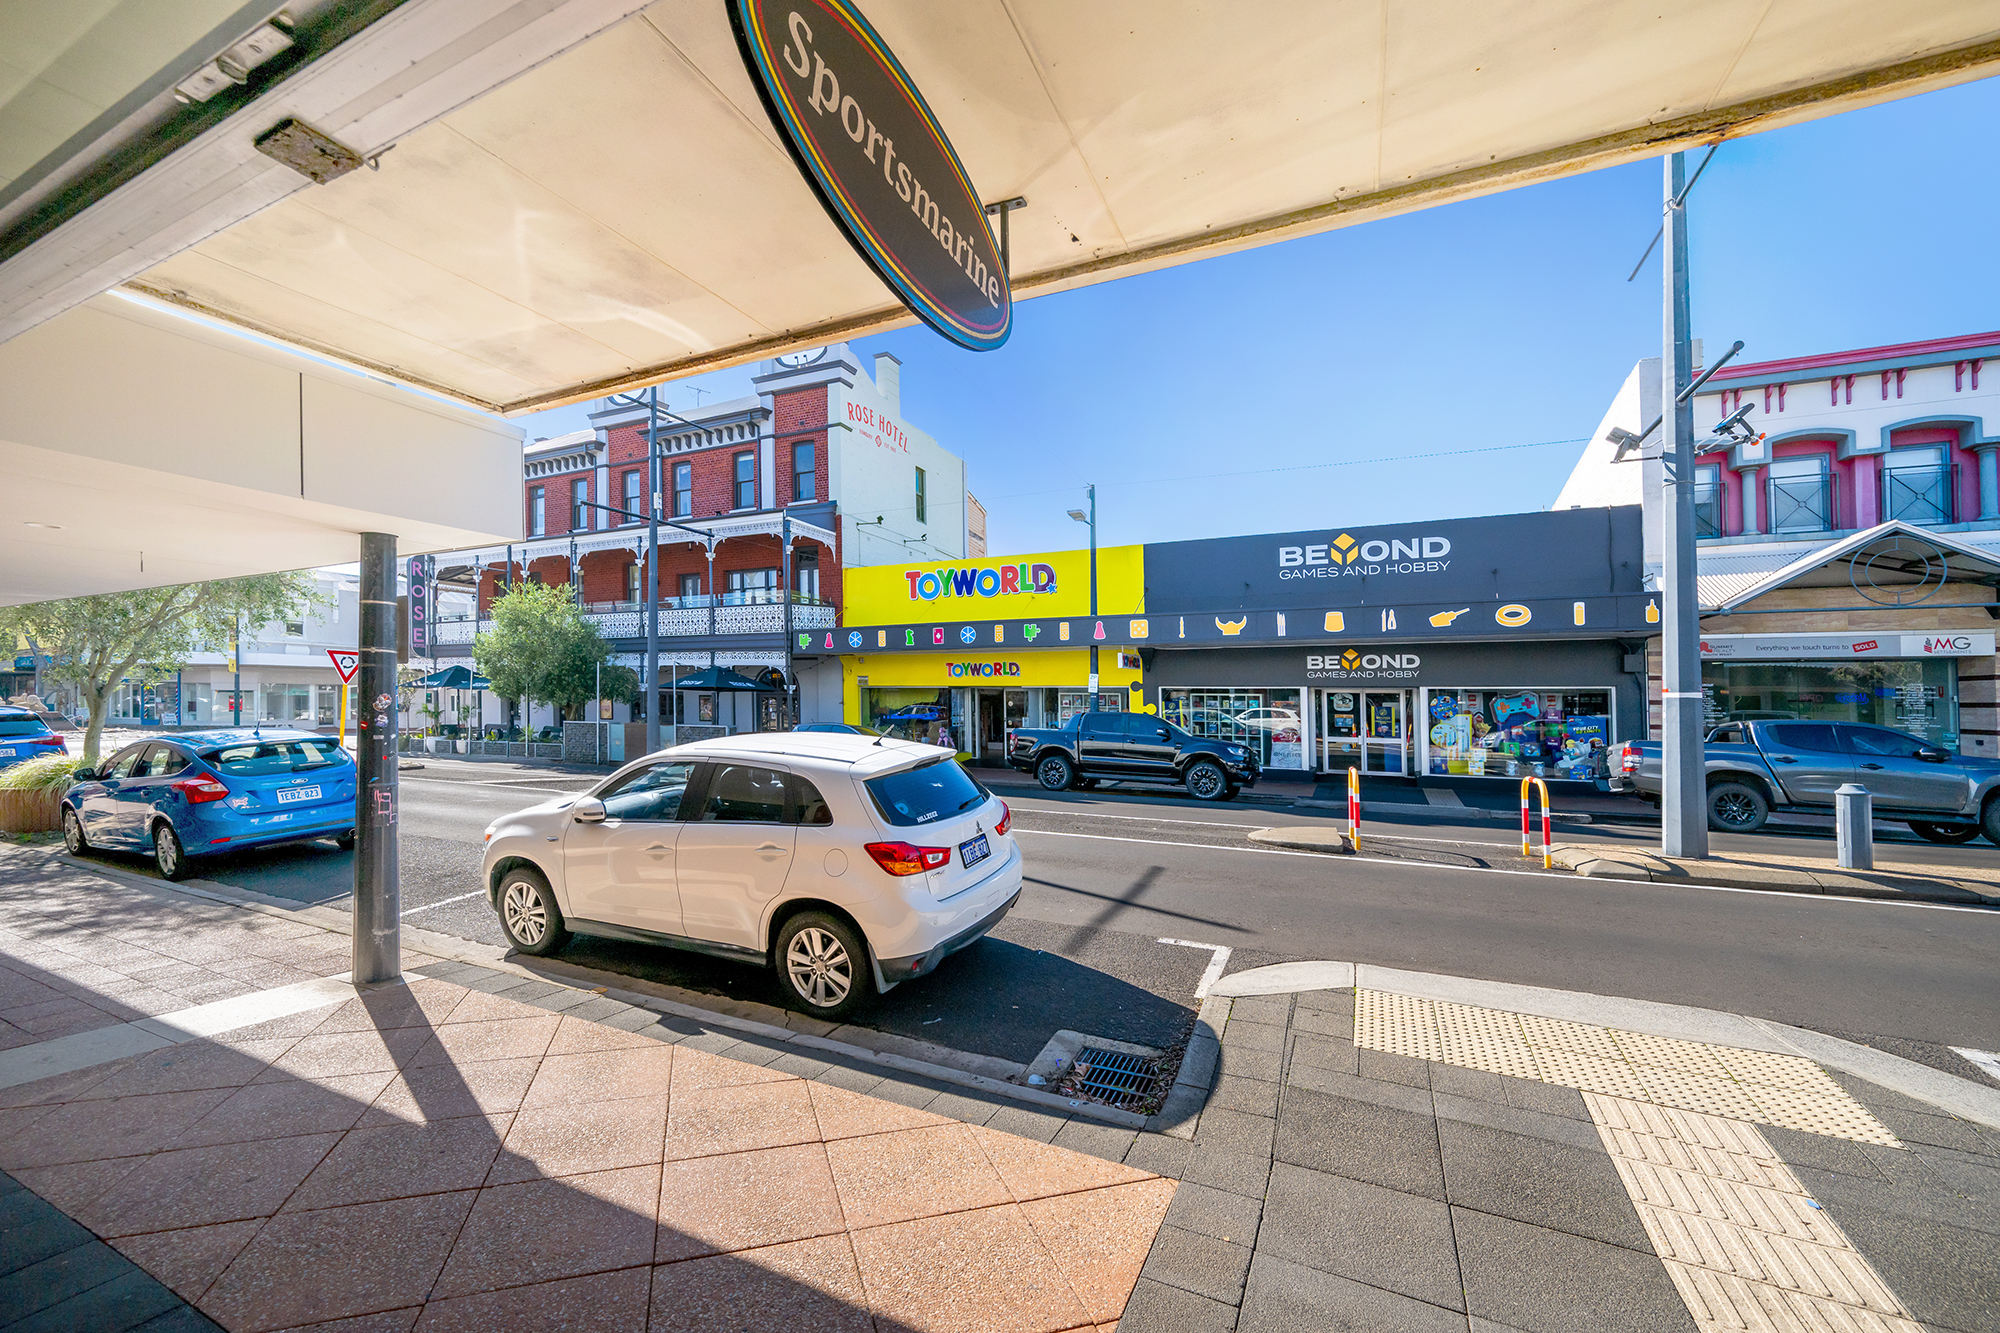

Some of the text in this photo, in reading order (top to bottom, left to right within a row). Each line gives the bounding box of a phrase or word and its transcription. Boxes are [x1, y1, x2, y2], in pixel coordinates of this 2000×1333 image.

[783, 11, 1000, 309] Sportsmarine
[846, 401, 908, 453] ROSE HOTEL
[1279, 532, 1451, 567] BEYOND
[1279, 560, 1451, 580] GAMES AND HOBBY
[905, 562, 1057, 601] TOYWORLD
[411, 560, 426, 643] ROSE
[1854, 642, 1876, 651] SOLD
[1933, 636, 1971, 650] MG
[945, 661, 1021, 678] TOYWORLD
[1307, 648, 1421, 670] BEYOND
[1307, 670, 1420, 679] GAMES AND HOBBY
